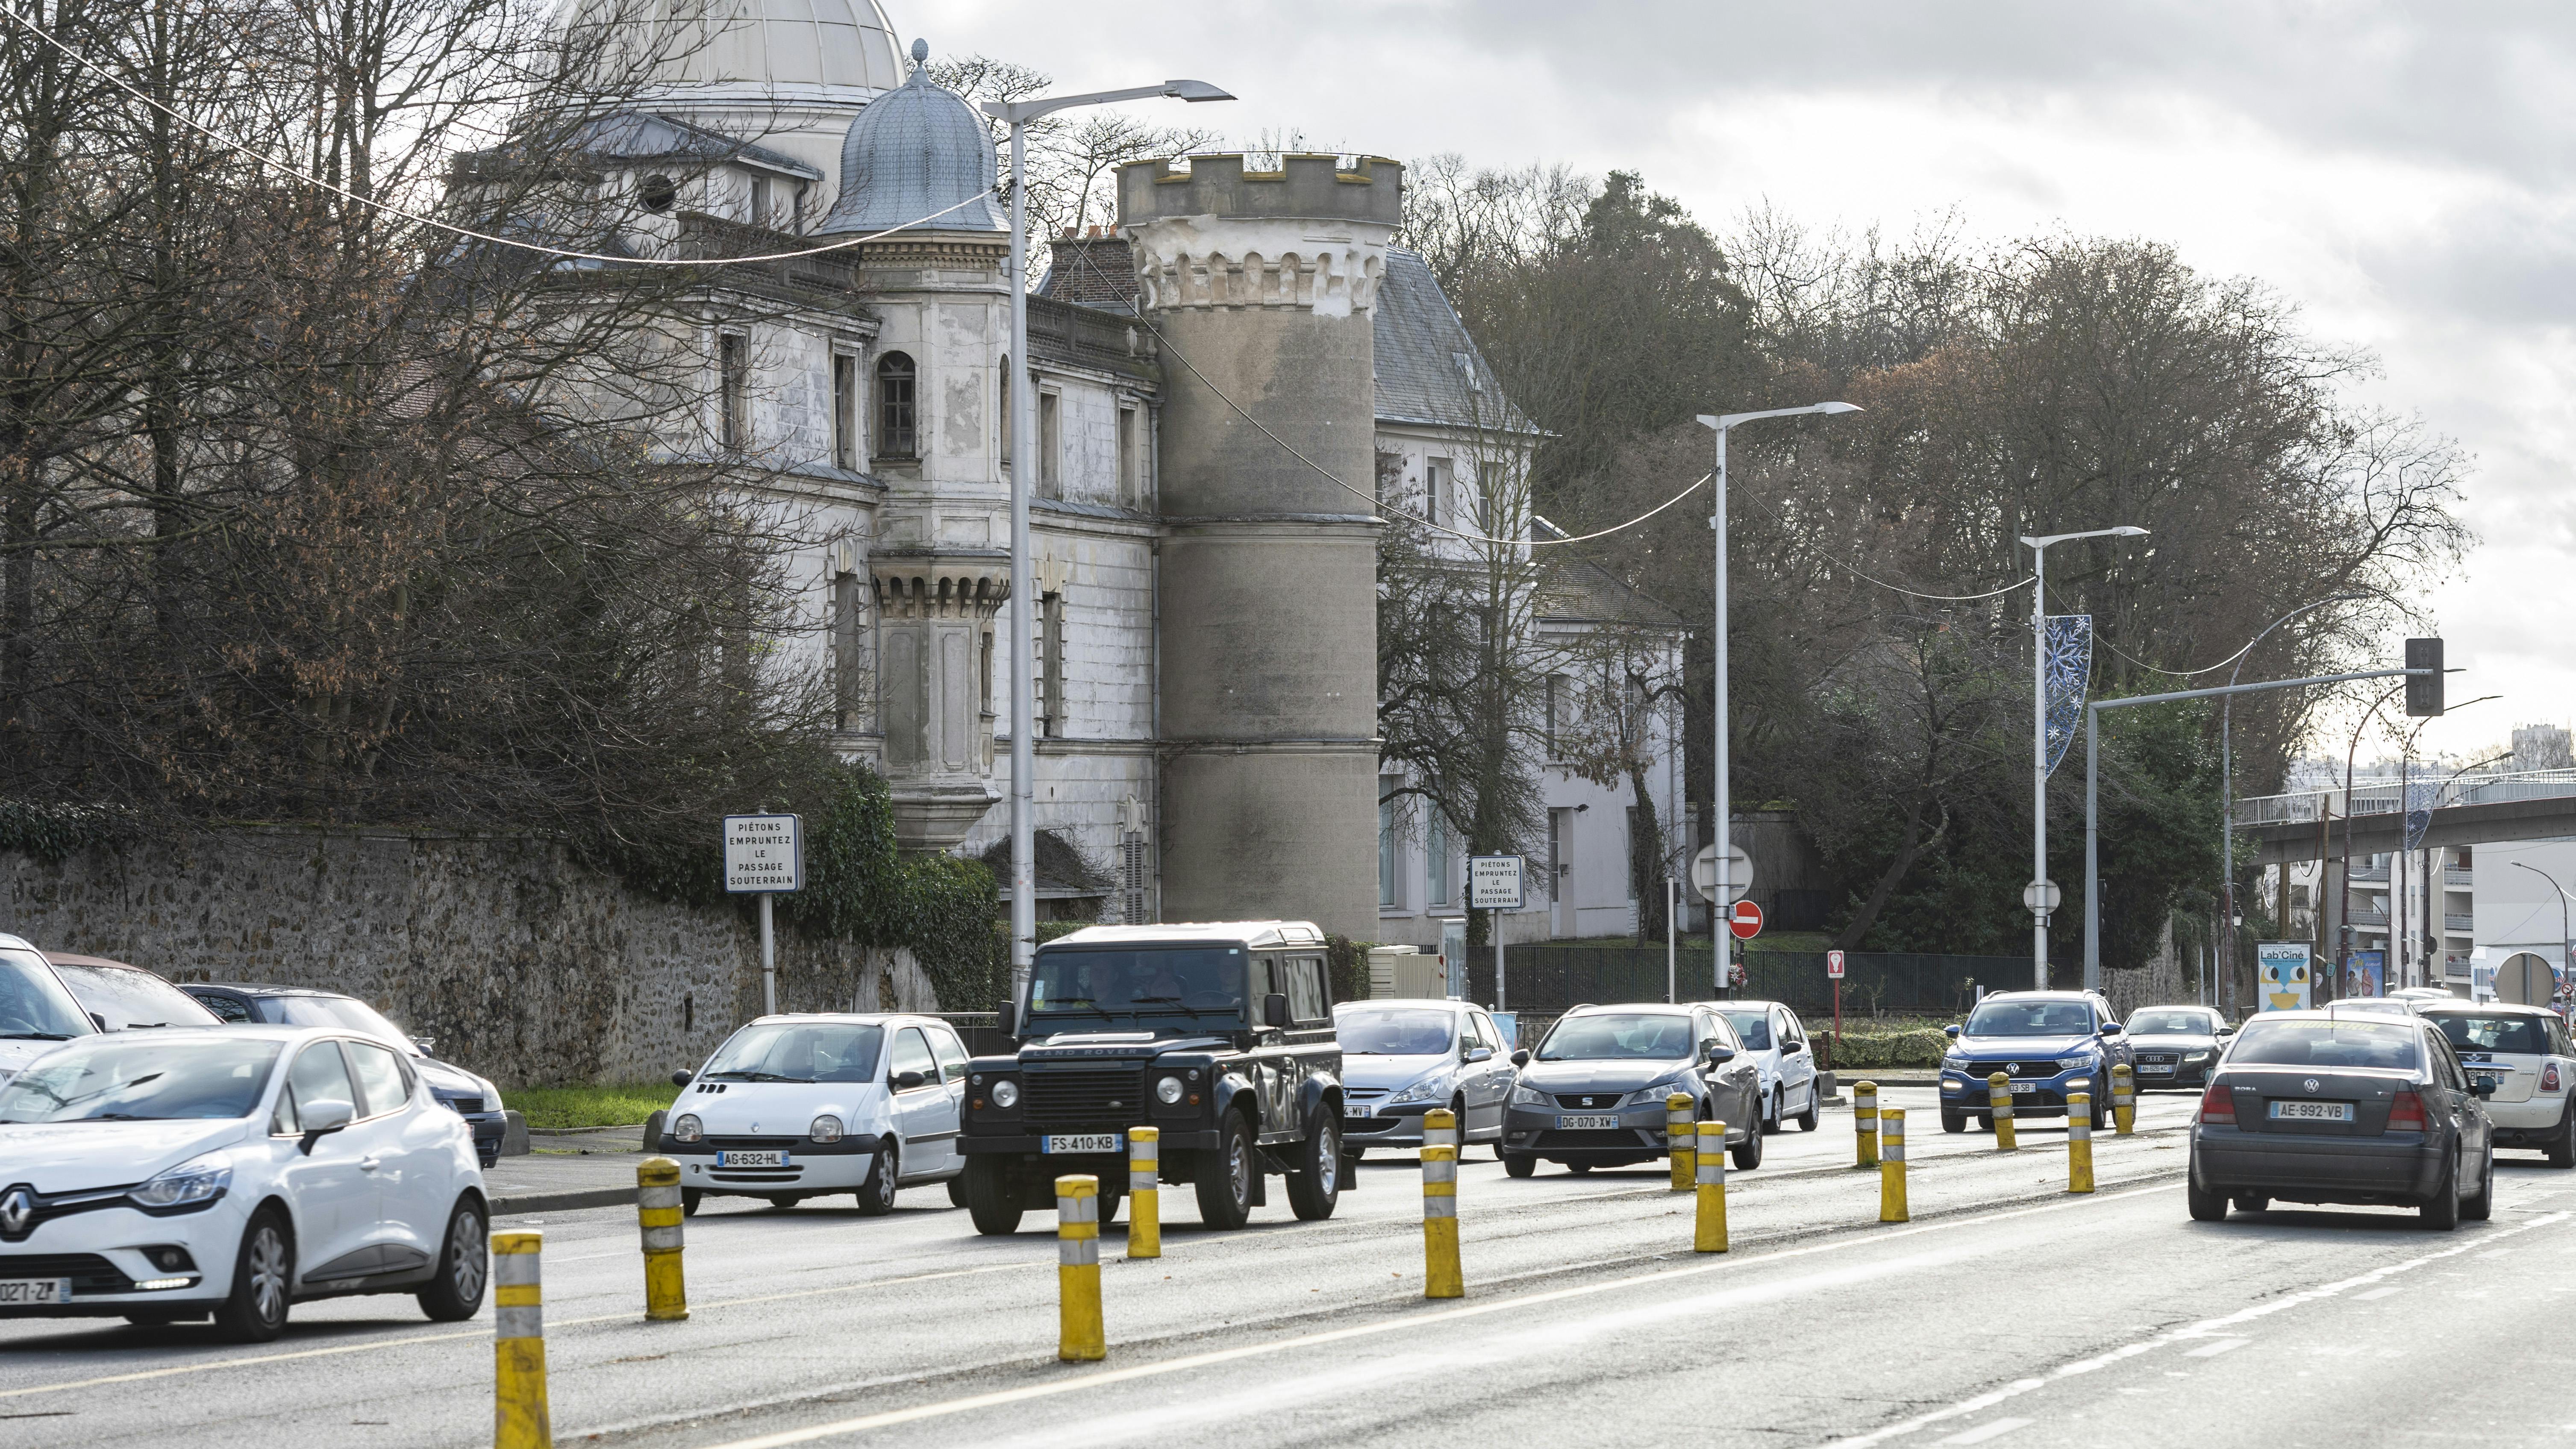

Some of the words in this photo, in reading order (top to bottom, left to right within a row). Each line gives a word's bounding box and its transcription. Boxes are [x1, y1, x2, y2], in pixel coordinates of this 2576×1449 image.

[738, 822, 781, 832] PIÉTONS
[729, 836, 791, 845] EMPRUNTEZ
[755, 850, 765, 858] LE
[738, 863, 783, 871] PASSAGE
[730, 876, 792, 885] SOUTERRAIN
[2281, 1104, 2343, 1117] AE-992-VB
[1562, 1117, 1611, 1128] DG-070-XW
[1051, 1136, 1113, 1150] FS-410-KB
[725, 1153, 780, 1165] AG-632-HL
